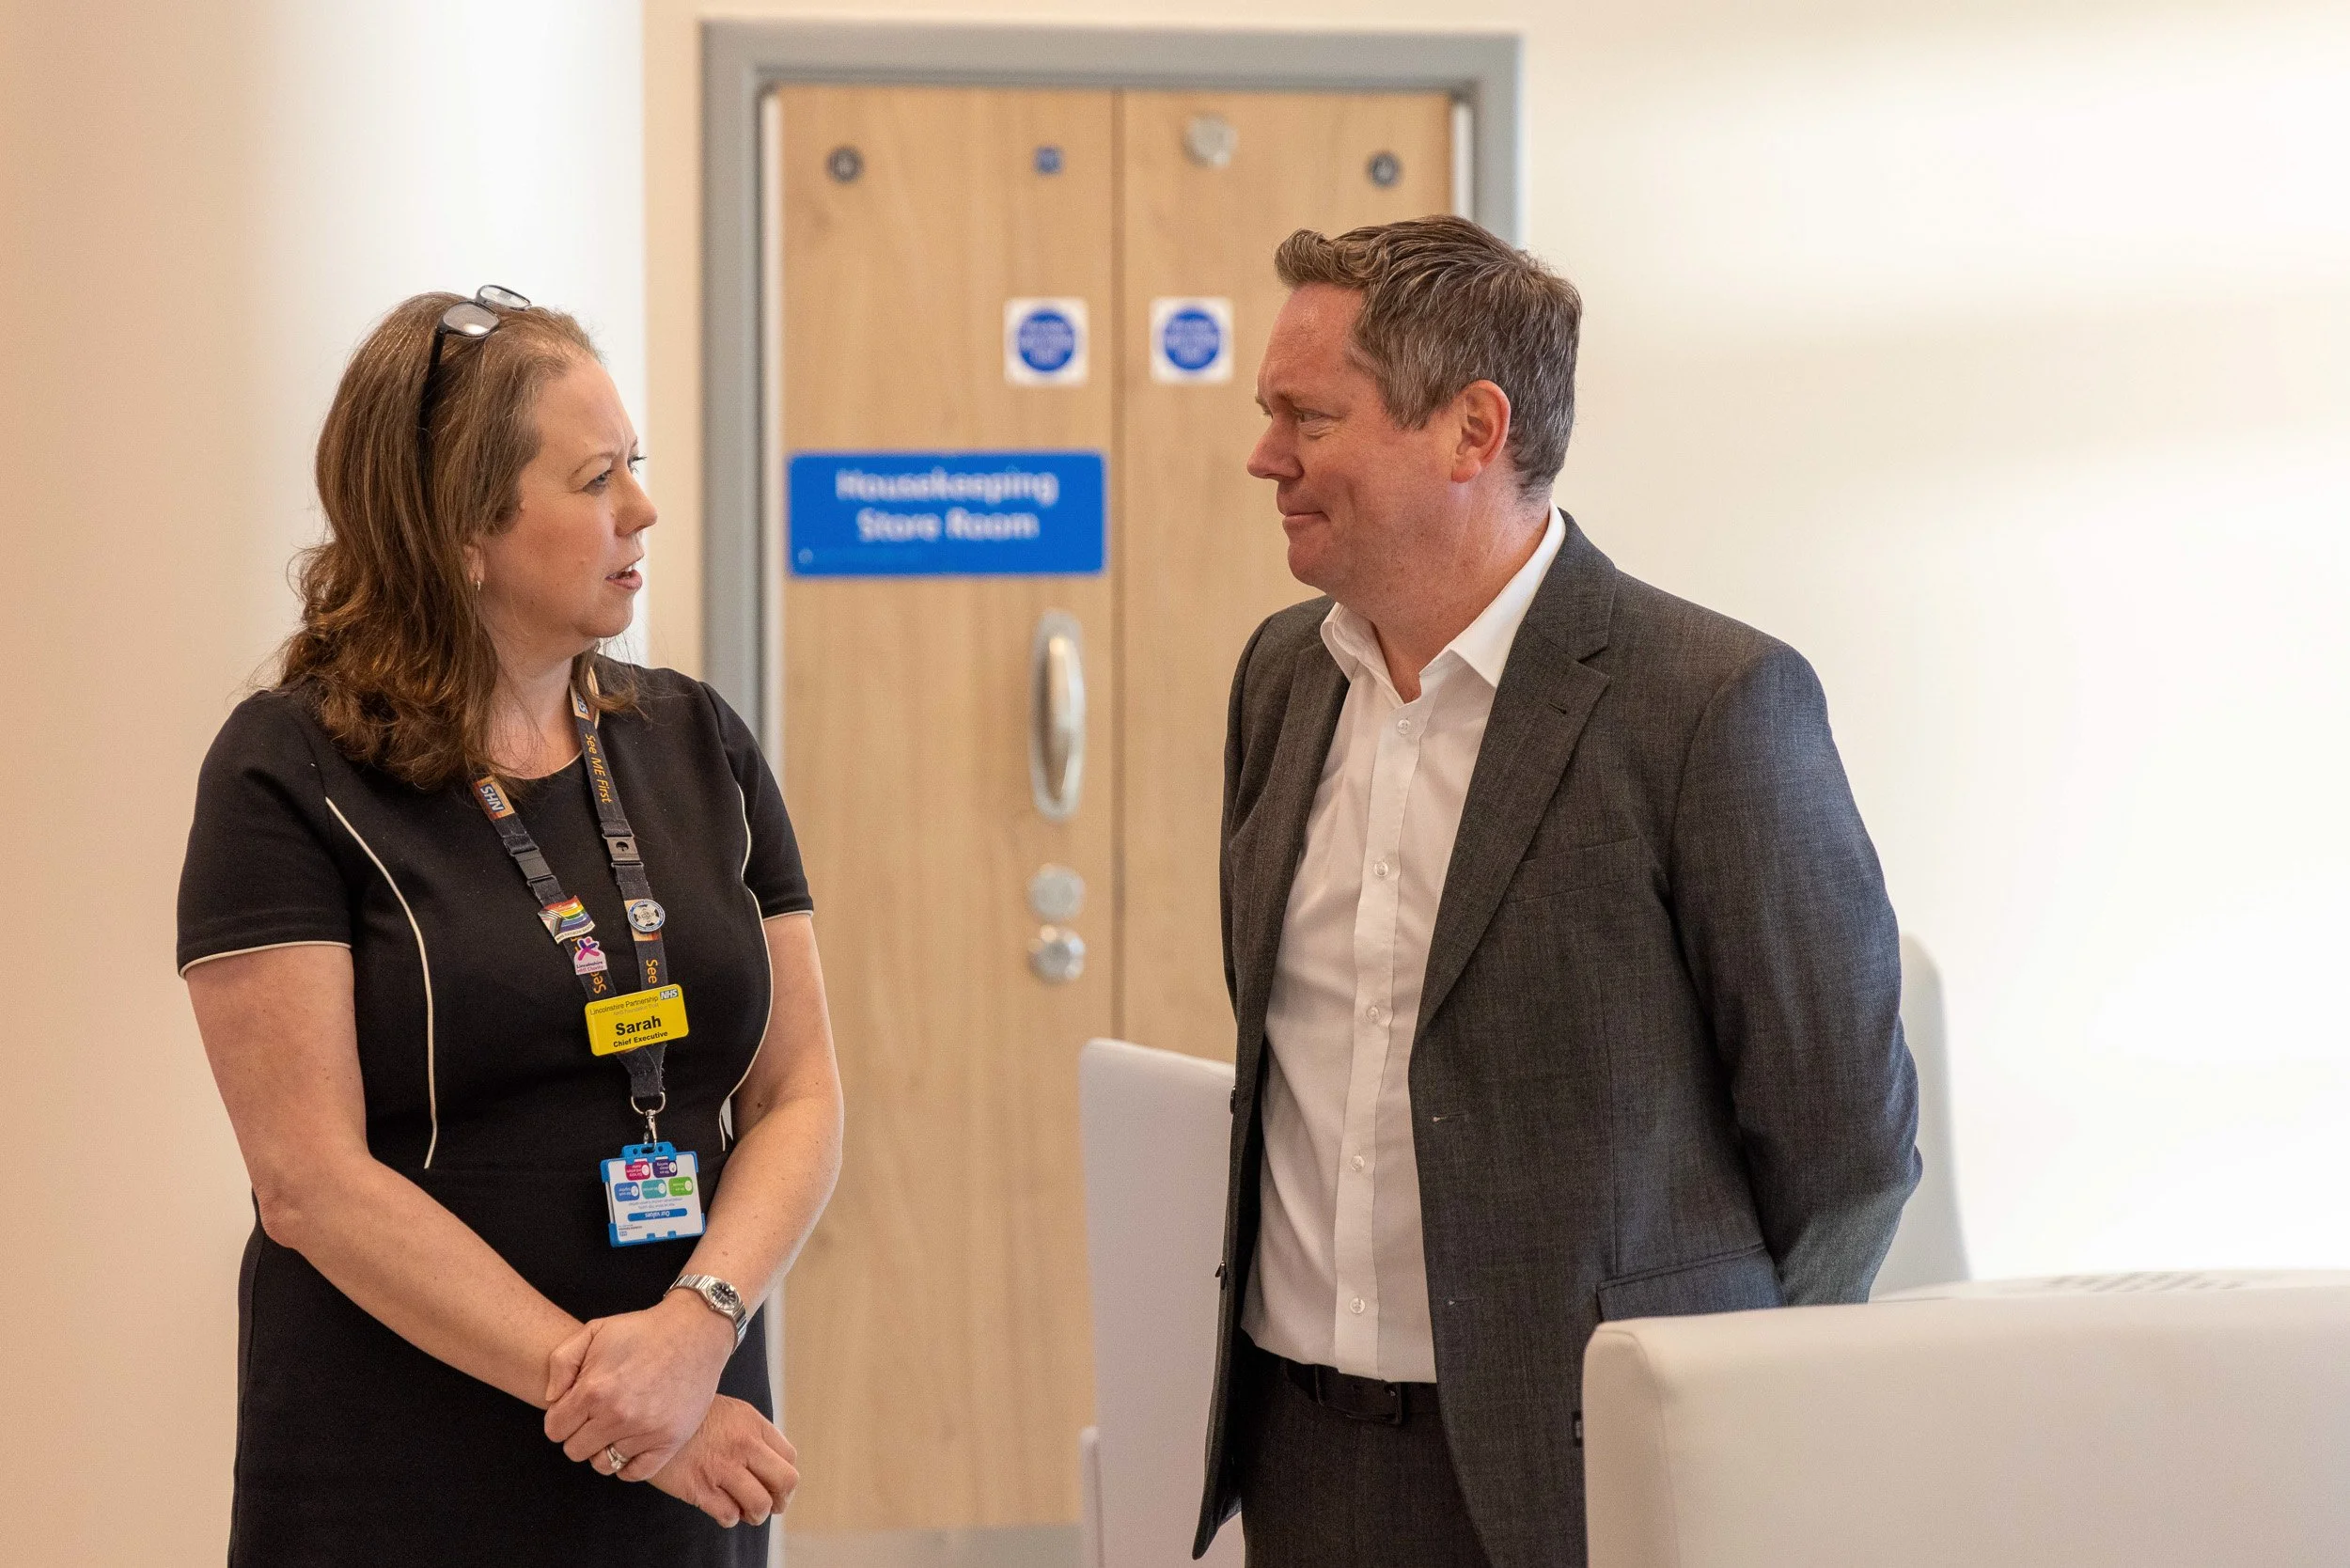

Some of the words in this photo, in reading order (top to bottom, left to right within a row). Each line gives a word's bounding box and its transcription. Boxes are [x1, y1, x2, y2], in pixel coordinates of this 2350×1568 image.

[836, 467, 1059, 508] Housekeeping
[856, 508, 941, 542] Store
[945, 507, 1040, 541] Room
[585, 733, 597, 754] See
[591, 757, 605, 776] ME
[480, 785, 505, 811] NHS
[597, 778, 613, 804] First
[646, 959, 658, 984] See
[660, 989, 678, 1000] NHS
[589, 1002, 624, 1016] Lincolnshire
[625, 996, 659, 1010] Partnership
[615, 1015, 662, 1036] Sarah
[613, 1038, 633, 1048] Chief
[634, 1031, 668, 1043] Executive
